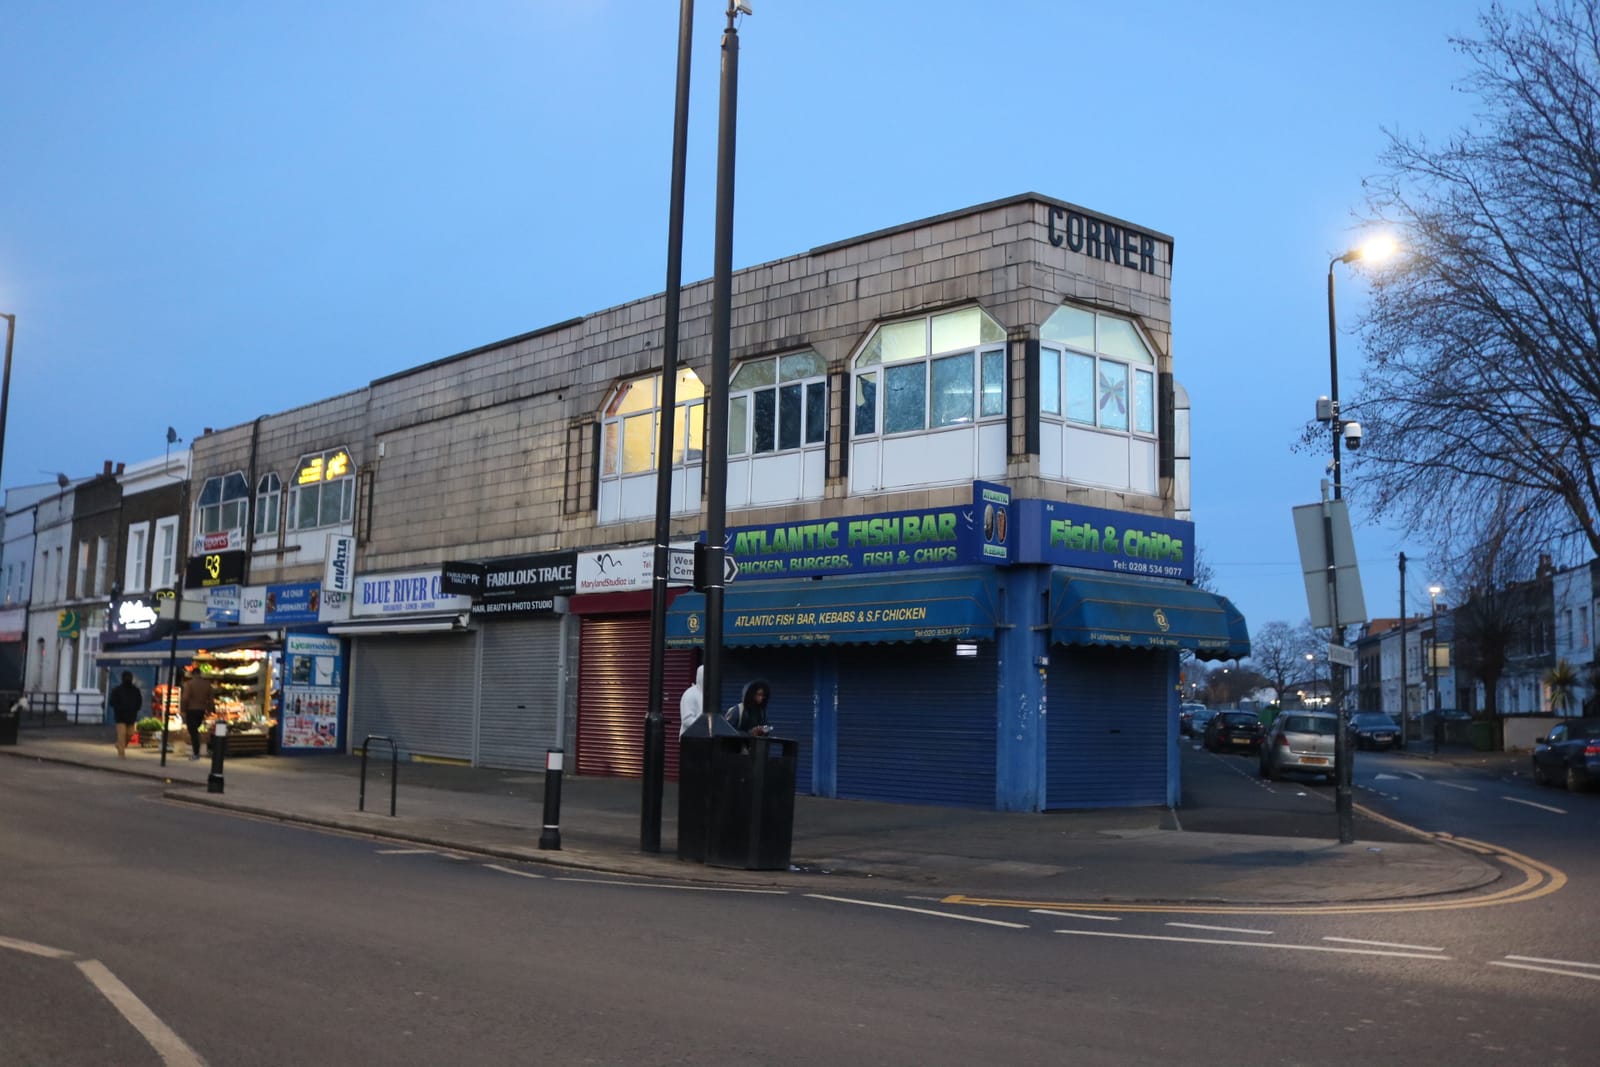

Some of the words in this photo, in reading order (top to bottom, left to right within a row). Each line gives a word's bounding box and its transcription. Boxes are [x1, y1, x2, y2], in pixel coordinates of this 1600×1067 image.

[1048, 206, 1155, 275] CORNER
[735, 521, 839, 556] ATLANTIC
[849, 517, 899, 546] FISH
[903, 512, 958, 542] BAR
[1103, 526, 1119, 553] &
[863, 551, 892, 565] FISH
[897, 550, 910, 564] &
[914, 546, 958, 563] CHIPS
[486, 569, 536, 588] FABULOUS
[538, 565, 572, 583] TRACE
[1113, 560, 1127, 570] Tel:
[1129, 561, 1147, 572] 0208
[1149, 563, 1162, 574] 534
[1164, 566, 1183, 576] 9077
[363, 581, 391, 604] BLUE
[394, 577, 427, 602] RIVER
[487, 602, 507, 612] BEAUTY
[512, 601, 530, 610] PHOTO
[531, 600, 552, 609] STUDIO
[735, 613, 774, 627] ATLANTIC
[775, 613, 794, 625] FISH
[819, 611, 855, 624] KEBABS
[857, 611, 865, 622] &
[882, 607, 926, 620] CHICKEN
